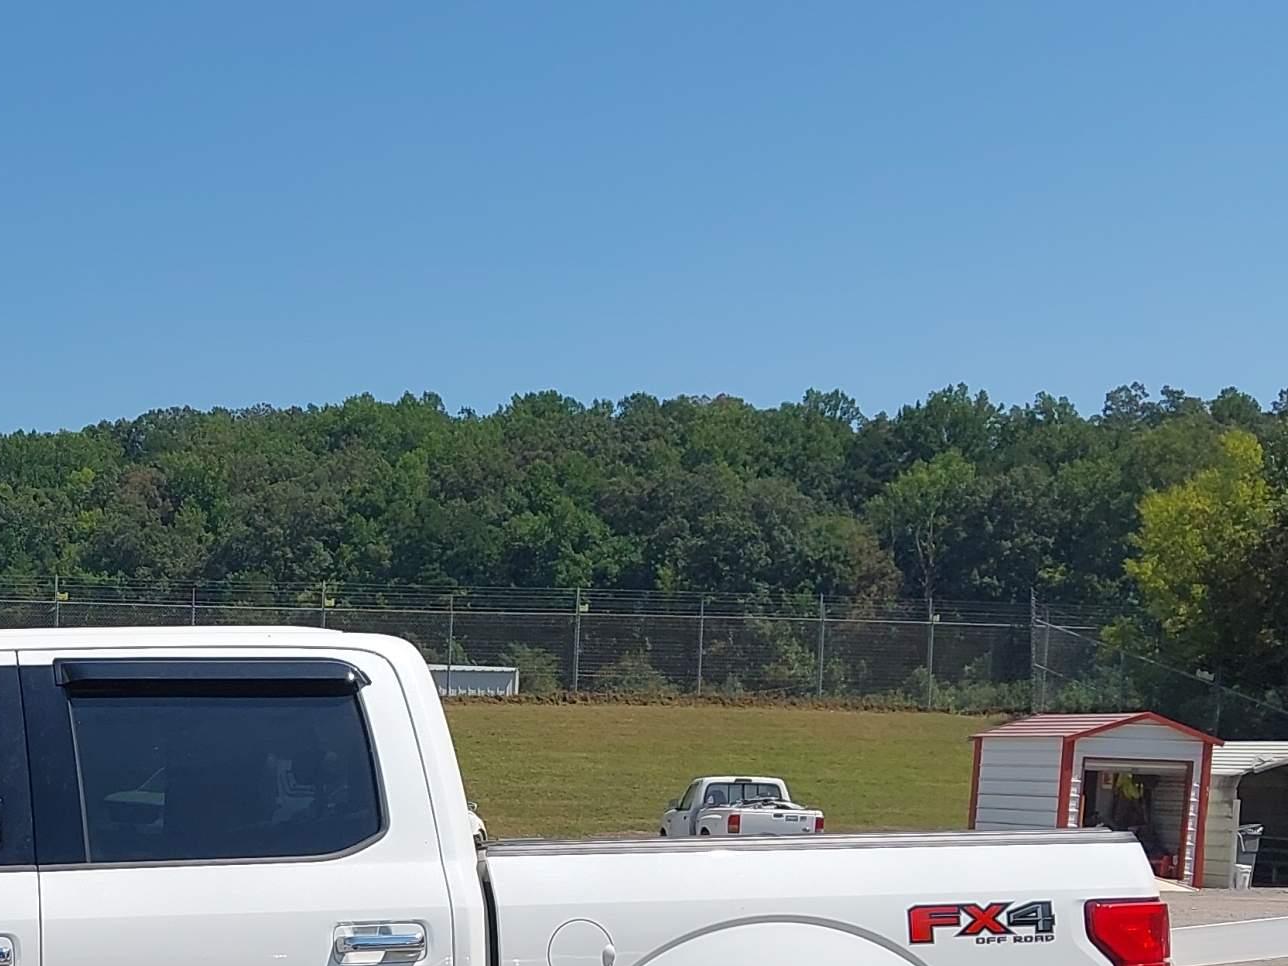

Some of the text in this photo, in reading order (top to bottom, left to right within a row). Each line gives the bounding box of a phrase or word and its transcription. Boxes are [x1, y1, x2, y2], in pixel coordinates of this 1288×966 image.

[907, 901, 1056, 945] FX4
[975, 935, 1055, 945] OFF ROAD
